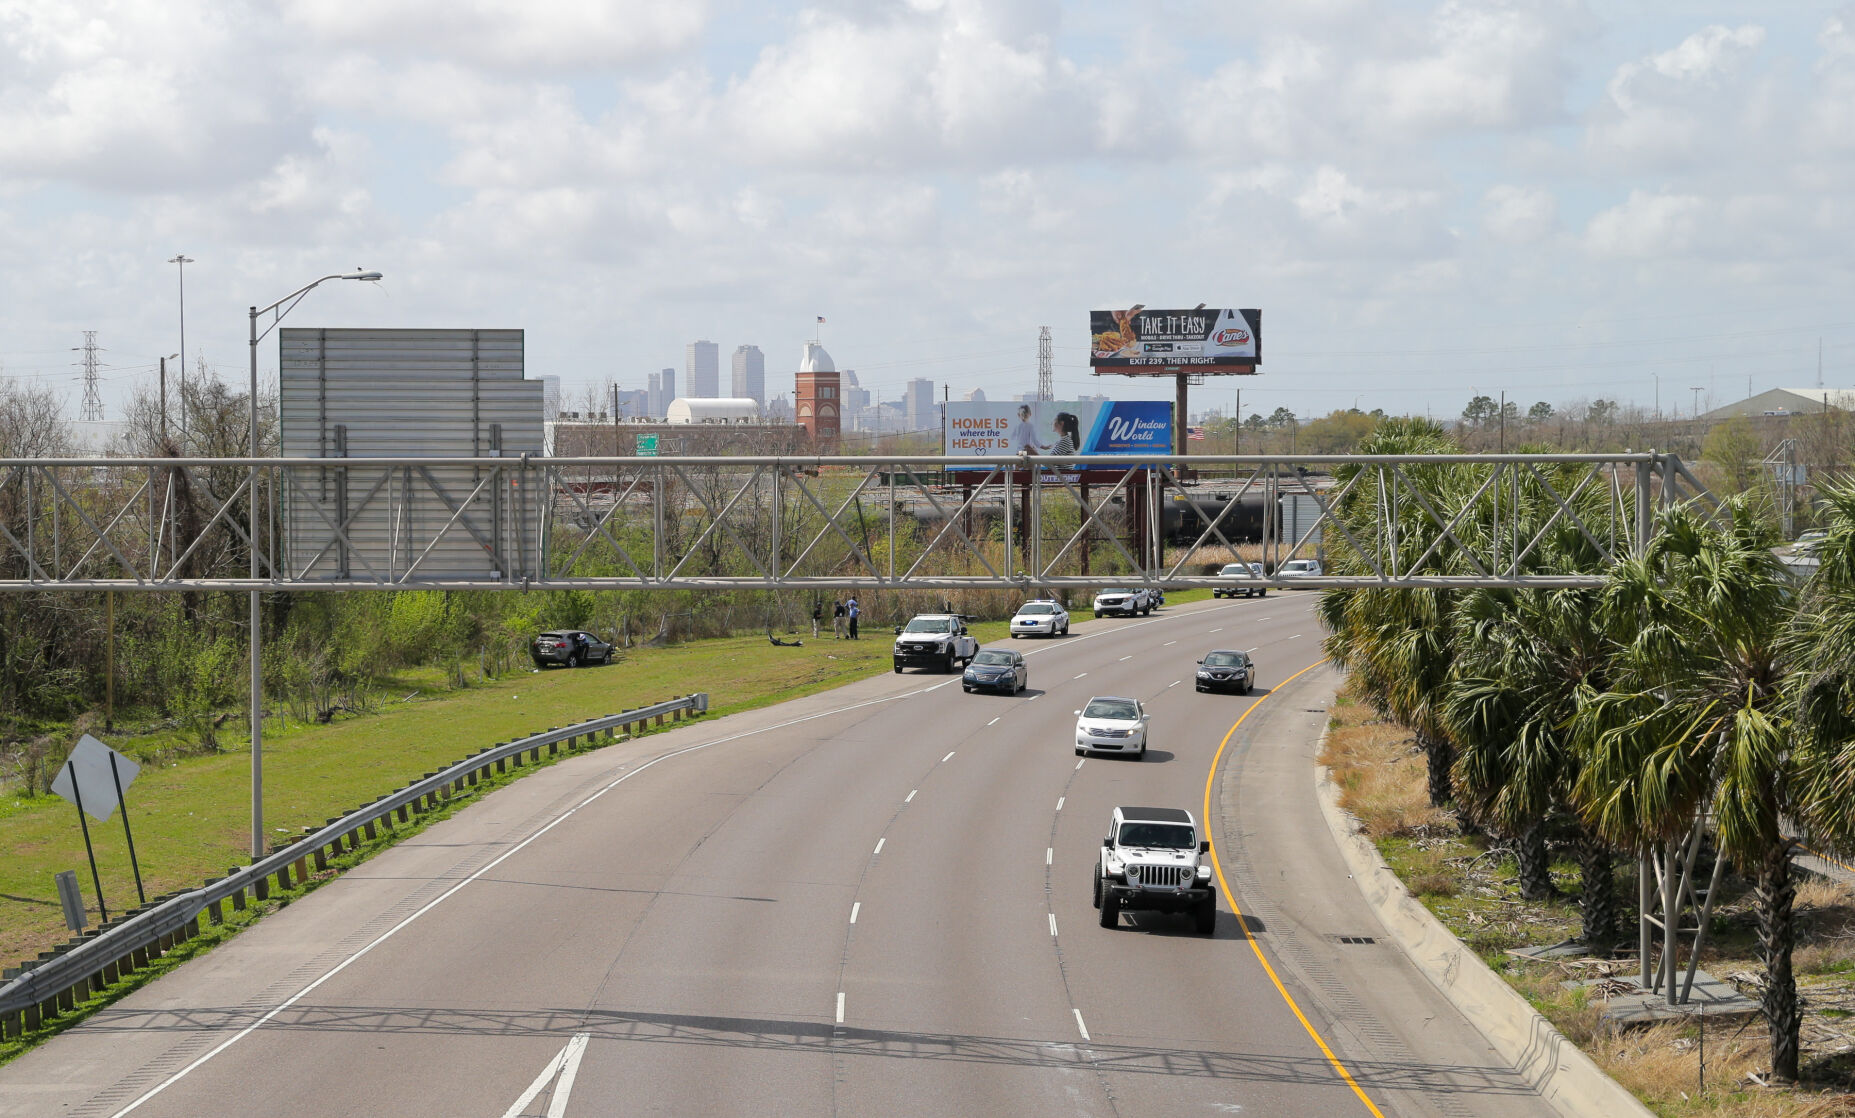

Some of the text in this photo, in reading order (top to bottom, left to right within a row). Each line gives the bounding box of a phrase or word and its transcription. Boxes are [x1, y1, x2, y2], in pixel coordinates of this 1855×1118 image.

[1140, 316, 1205, 334] TAKE IT EASY
[1213, 329, 1249, 346] Cane's
[1167, 357, 1188, 365] THEN
[952, 418, 1008, 429] HOME IS
[959, 429, 1001, 437] where the
[952, 438, 1009, 448] HEART IS
